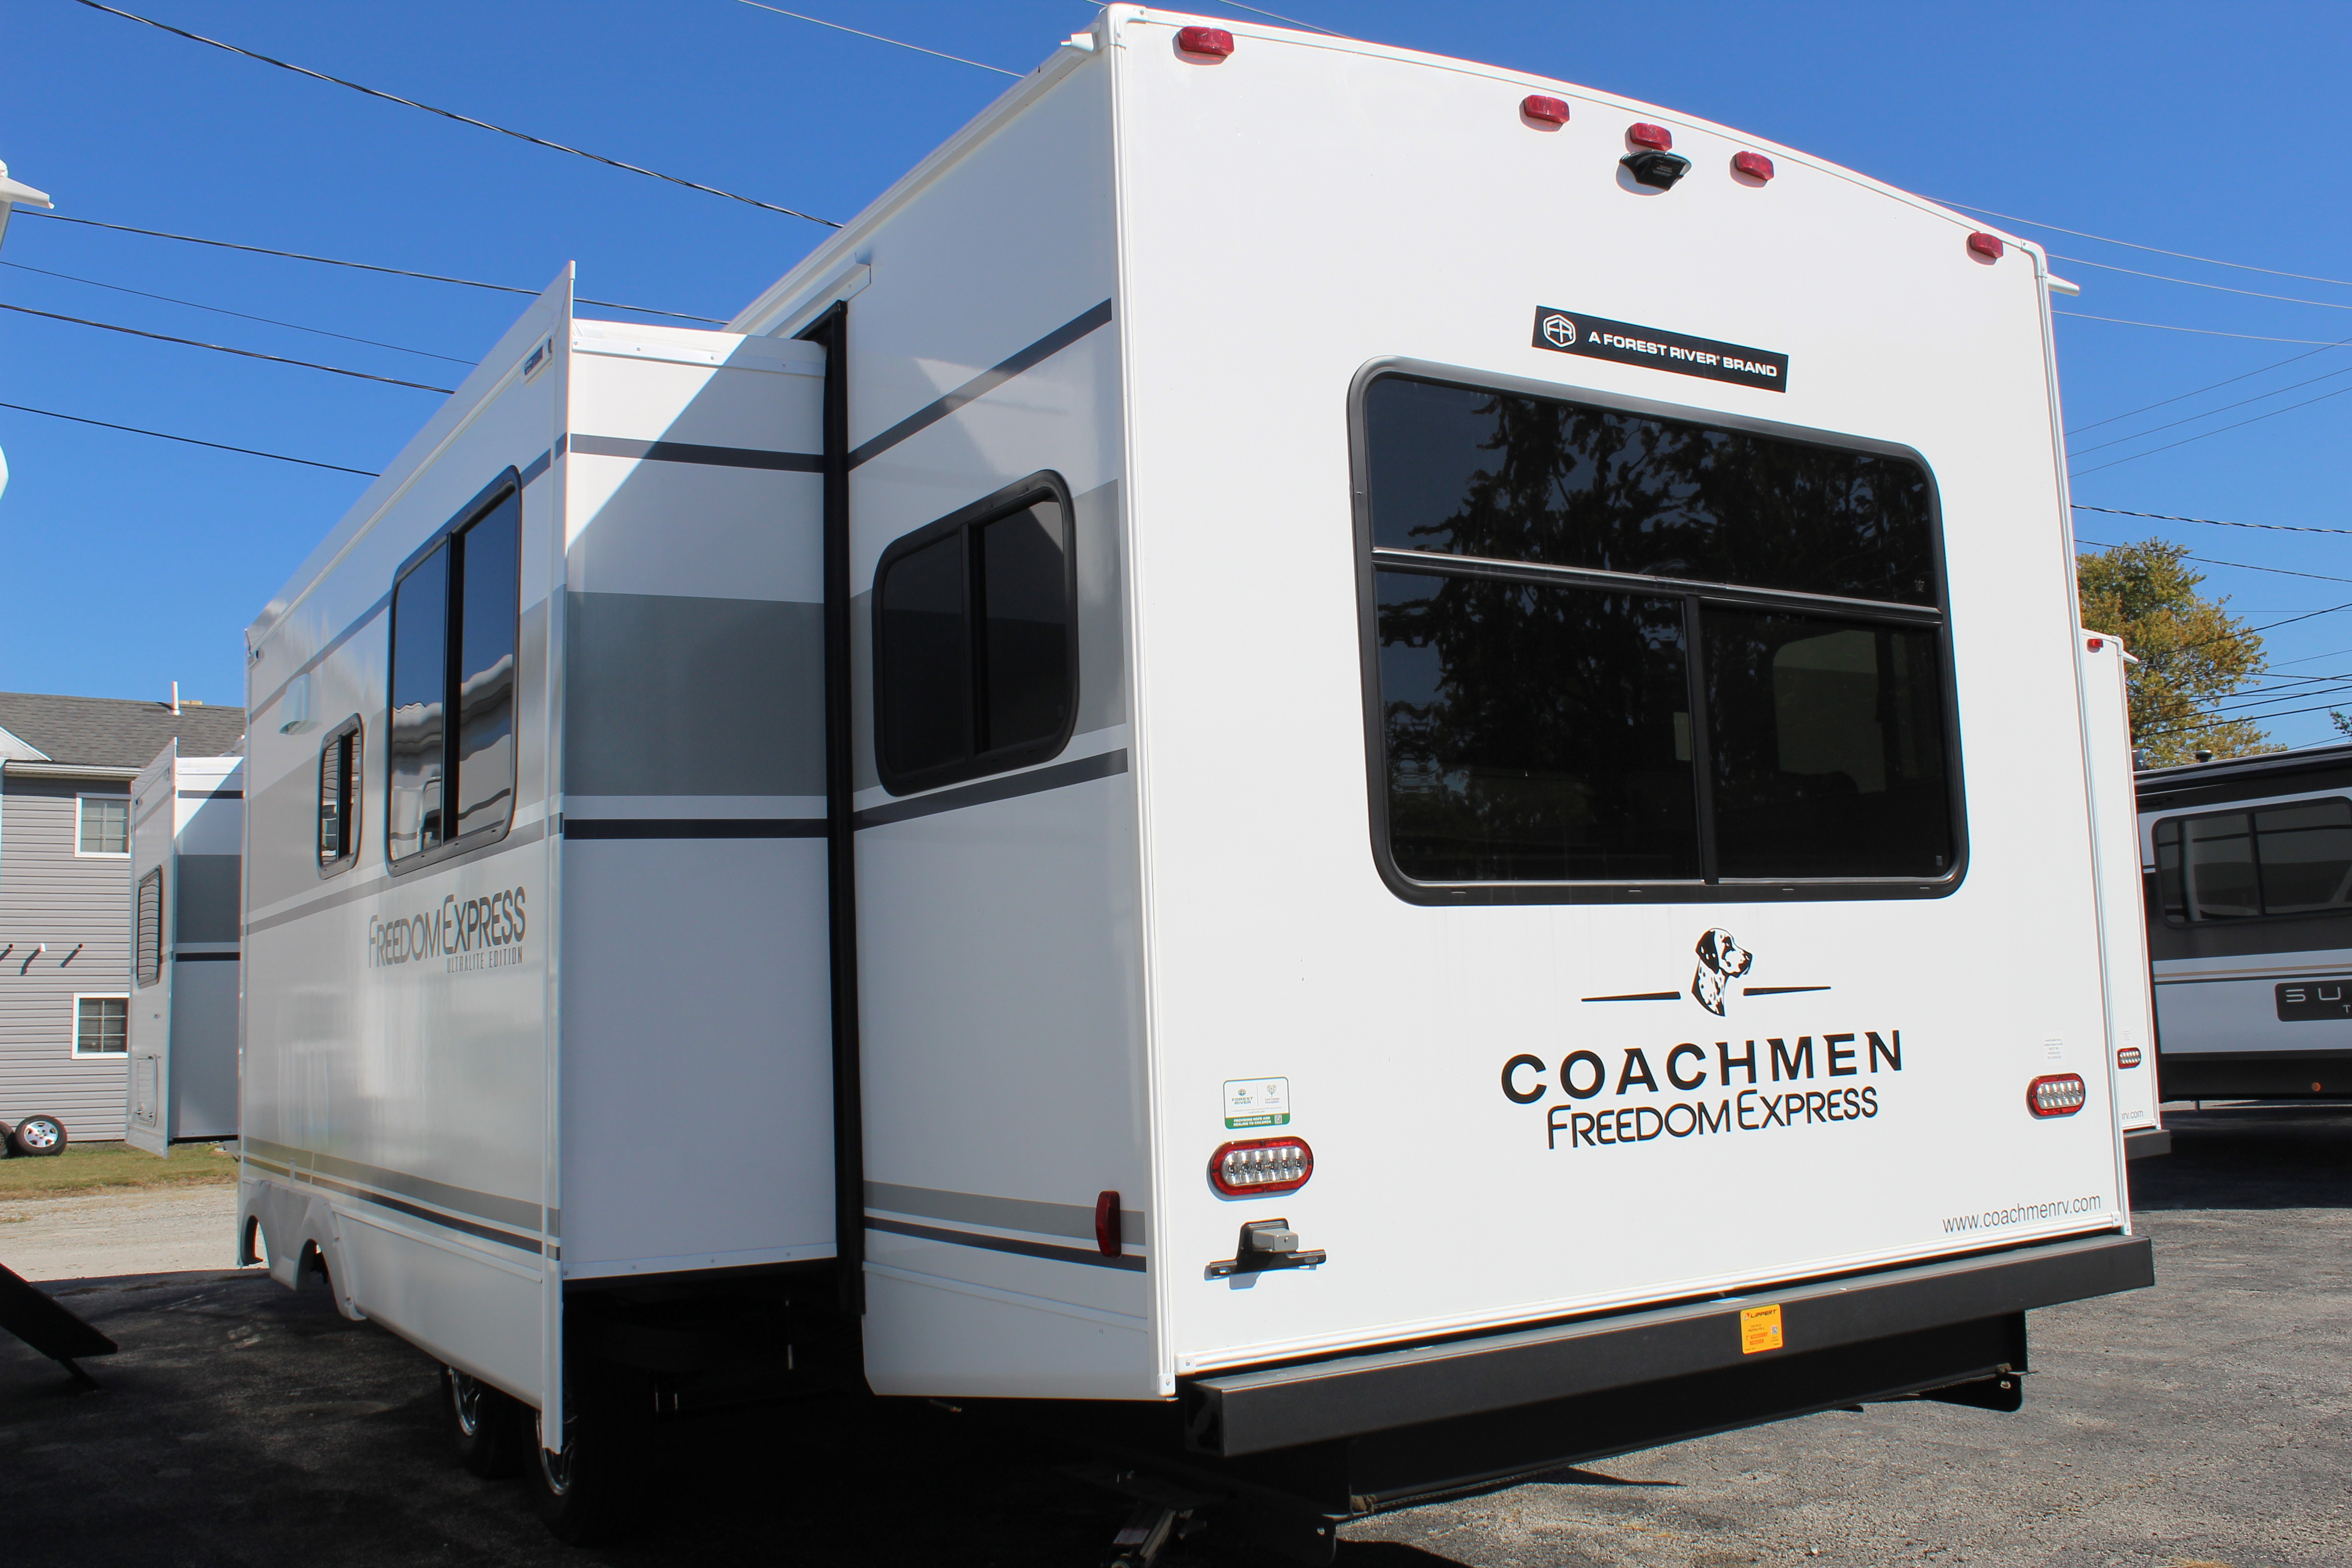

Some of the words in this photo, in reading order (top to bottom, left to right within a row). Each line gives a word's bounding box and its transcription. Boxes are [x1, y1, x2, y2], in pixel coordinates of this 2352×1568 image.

[1588, 331, 1601, 344] A
[1603, 333, 1667, 357] FOREST
[1722, 356, 1778, 377] BRAND
[447, 952, 485, 973] ULTRALITE
[489, 946, 523, 968] EDITION
[1500, 1030, 1902, 1104] COACHMEN
[1941, 1195, 2102, 1234] www.coachmenrv.com
